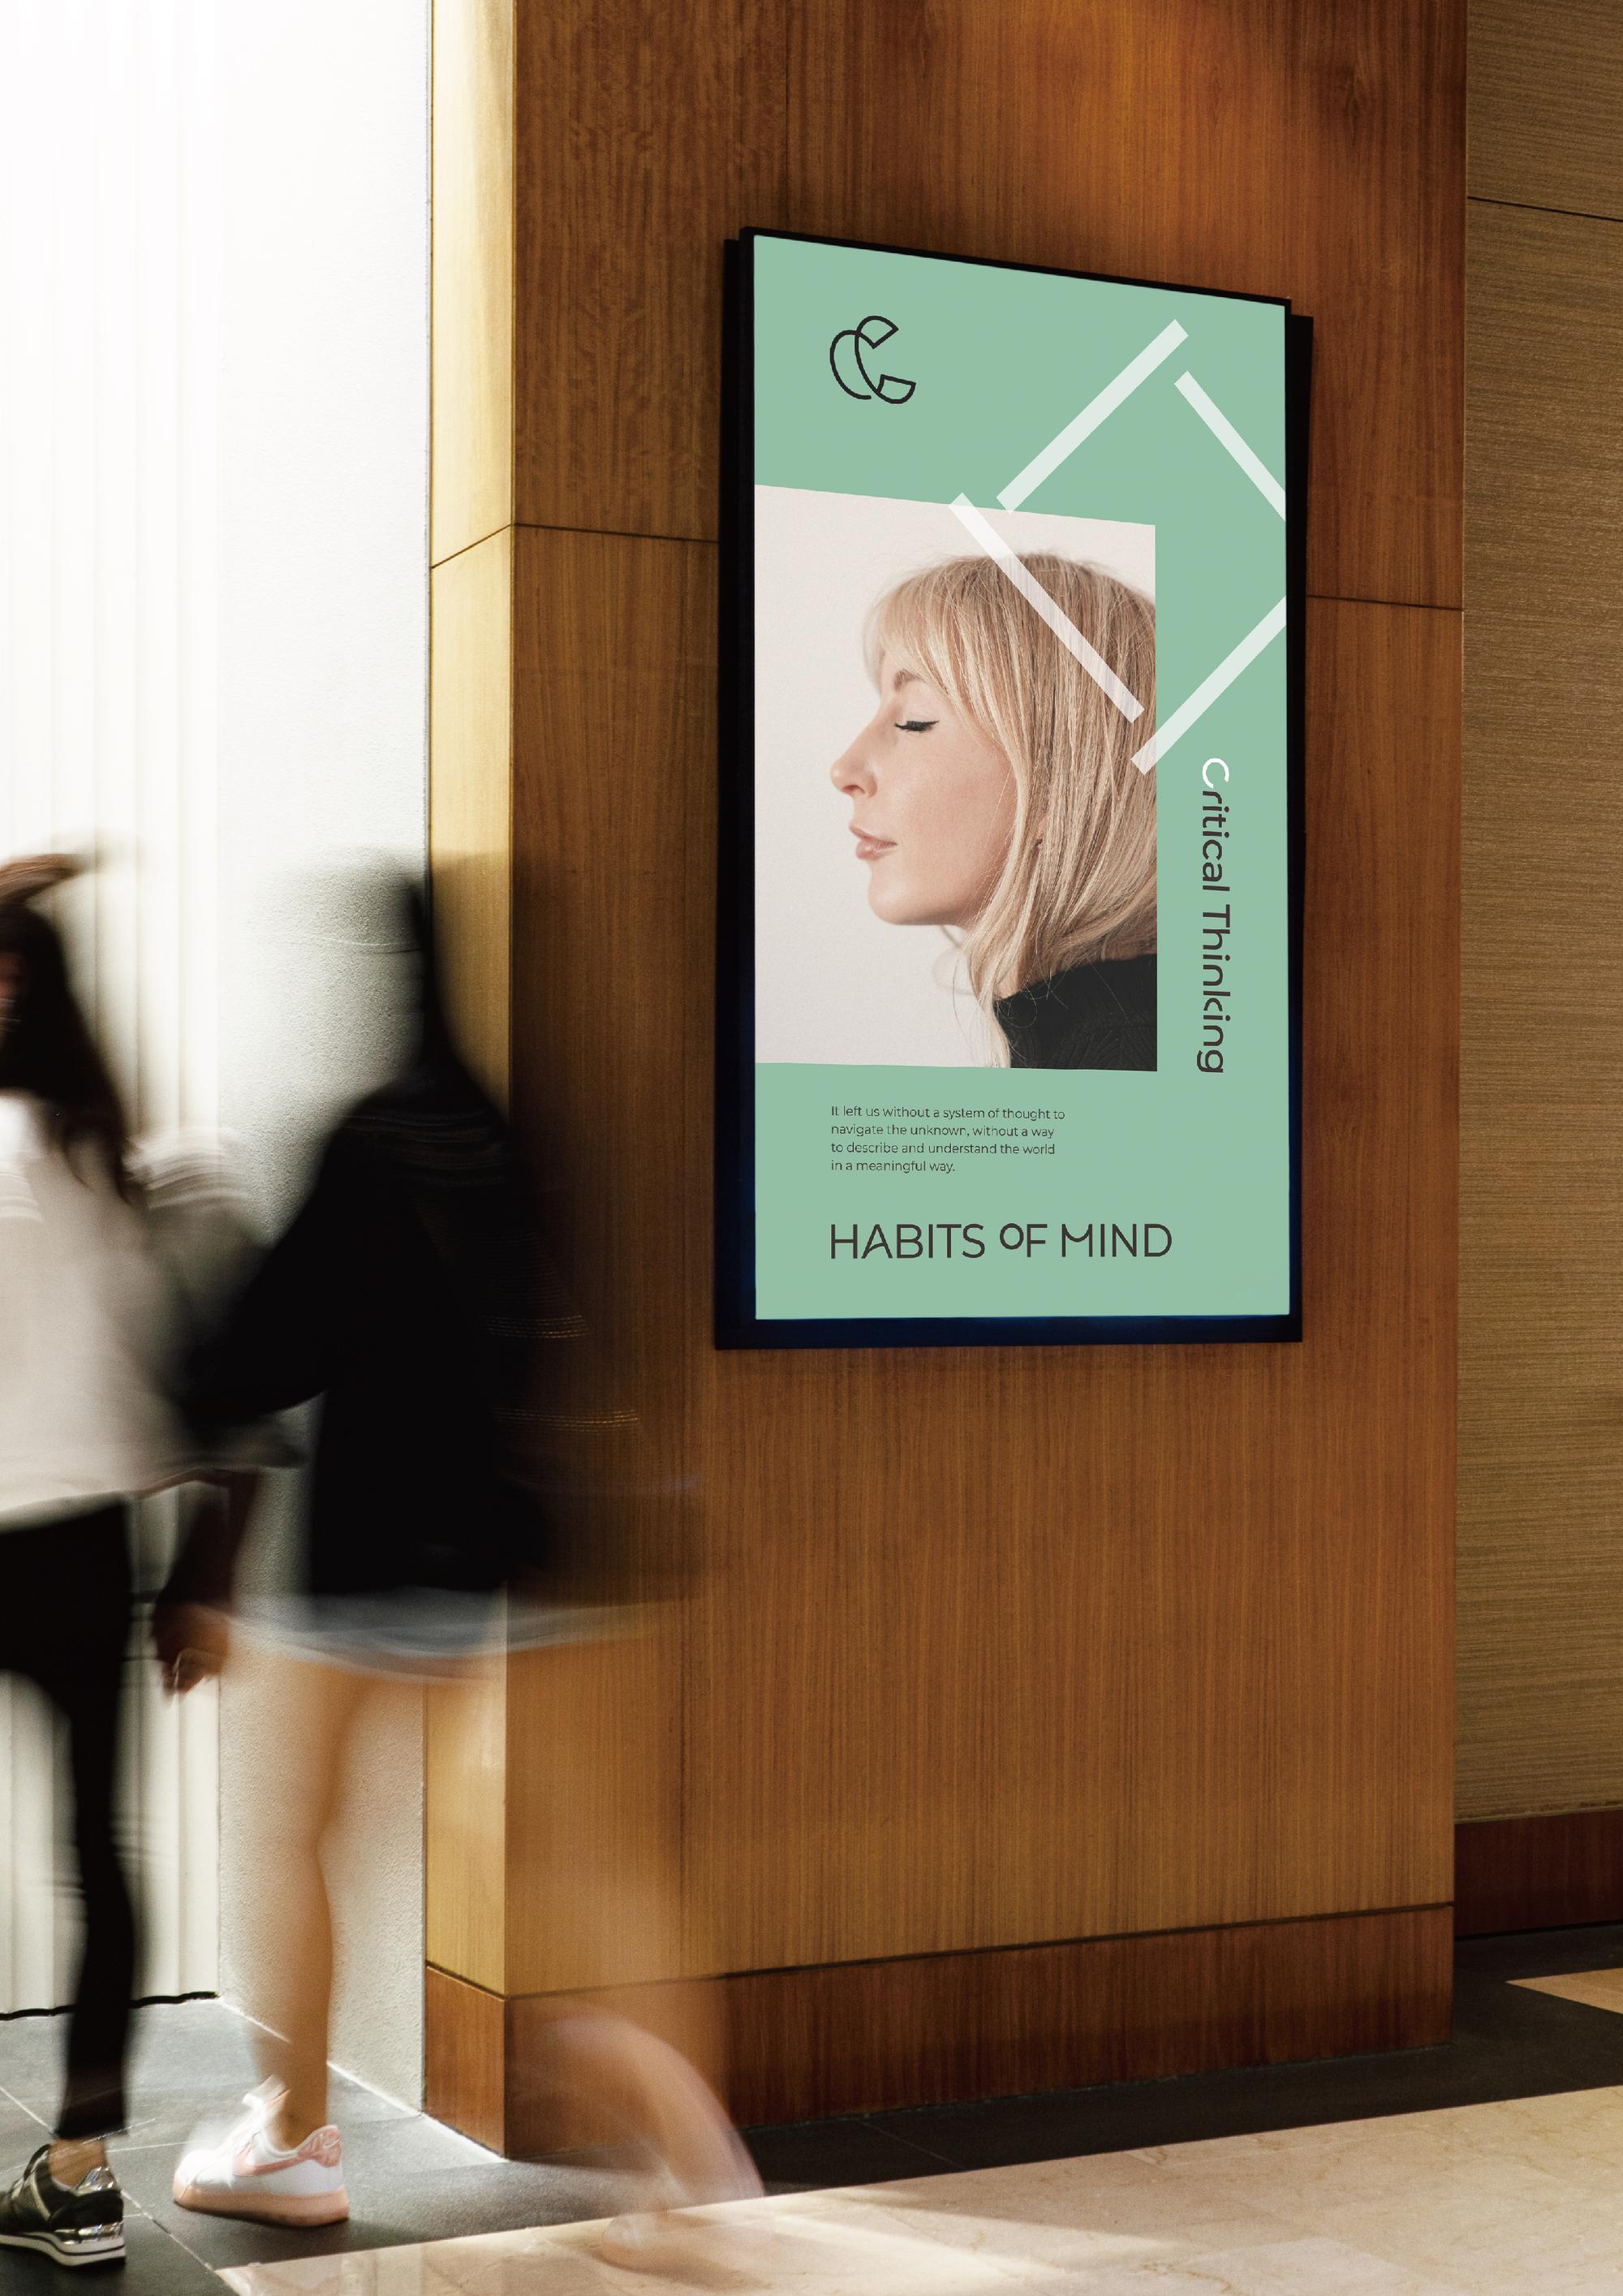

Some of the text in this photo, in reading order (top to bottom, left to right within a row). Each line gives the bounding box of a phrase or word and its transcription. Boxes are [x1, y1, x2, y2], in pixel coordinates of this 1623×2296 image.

[1196, 757, 1231, 1075] Critical Thinking
[831, 1105, 1065, 1122] It left us without a system of thought to
[831, 1123, 1055, 1139] navigate the unknown, without a way
[830, 1141, 1055, 1156] to describe and understand the world
[831, 1159, 955, 1174] in a meaningful way.
[829, 1222, 1173, 1260] HABITS OF MIND
